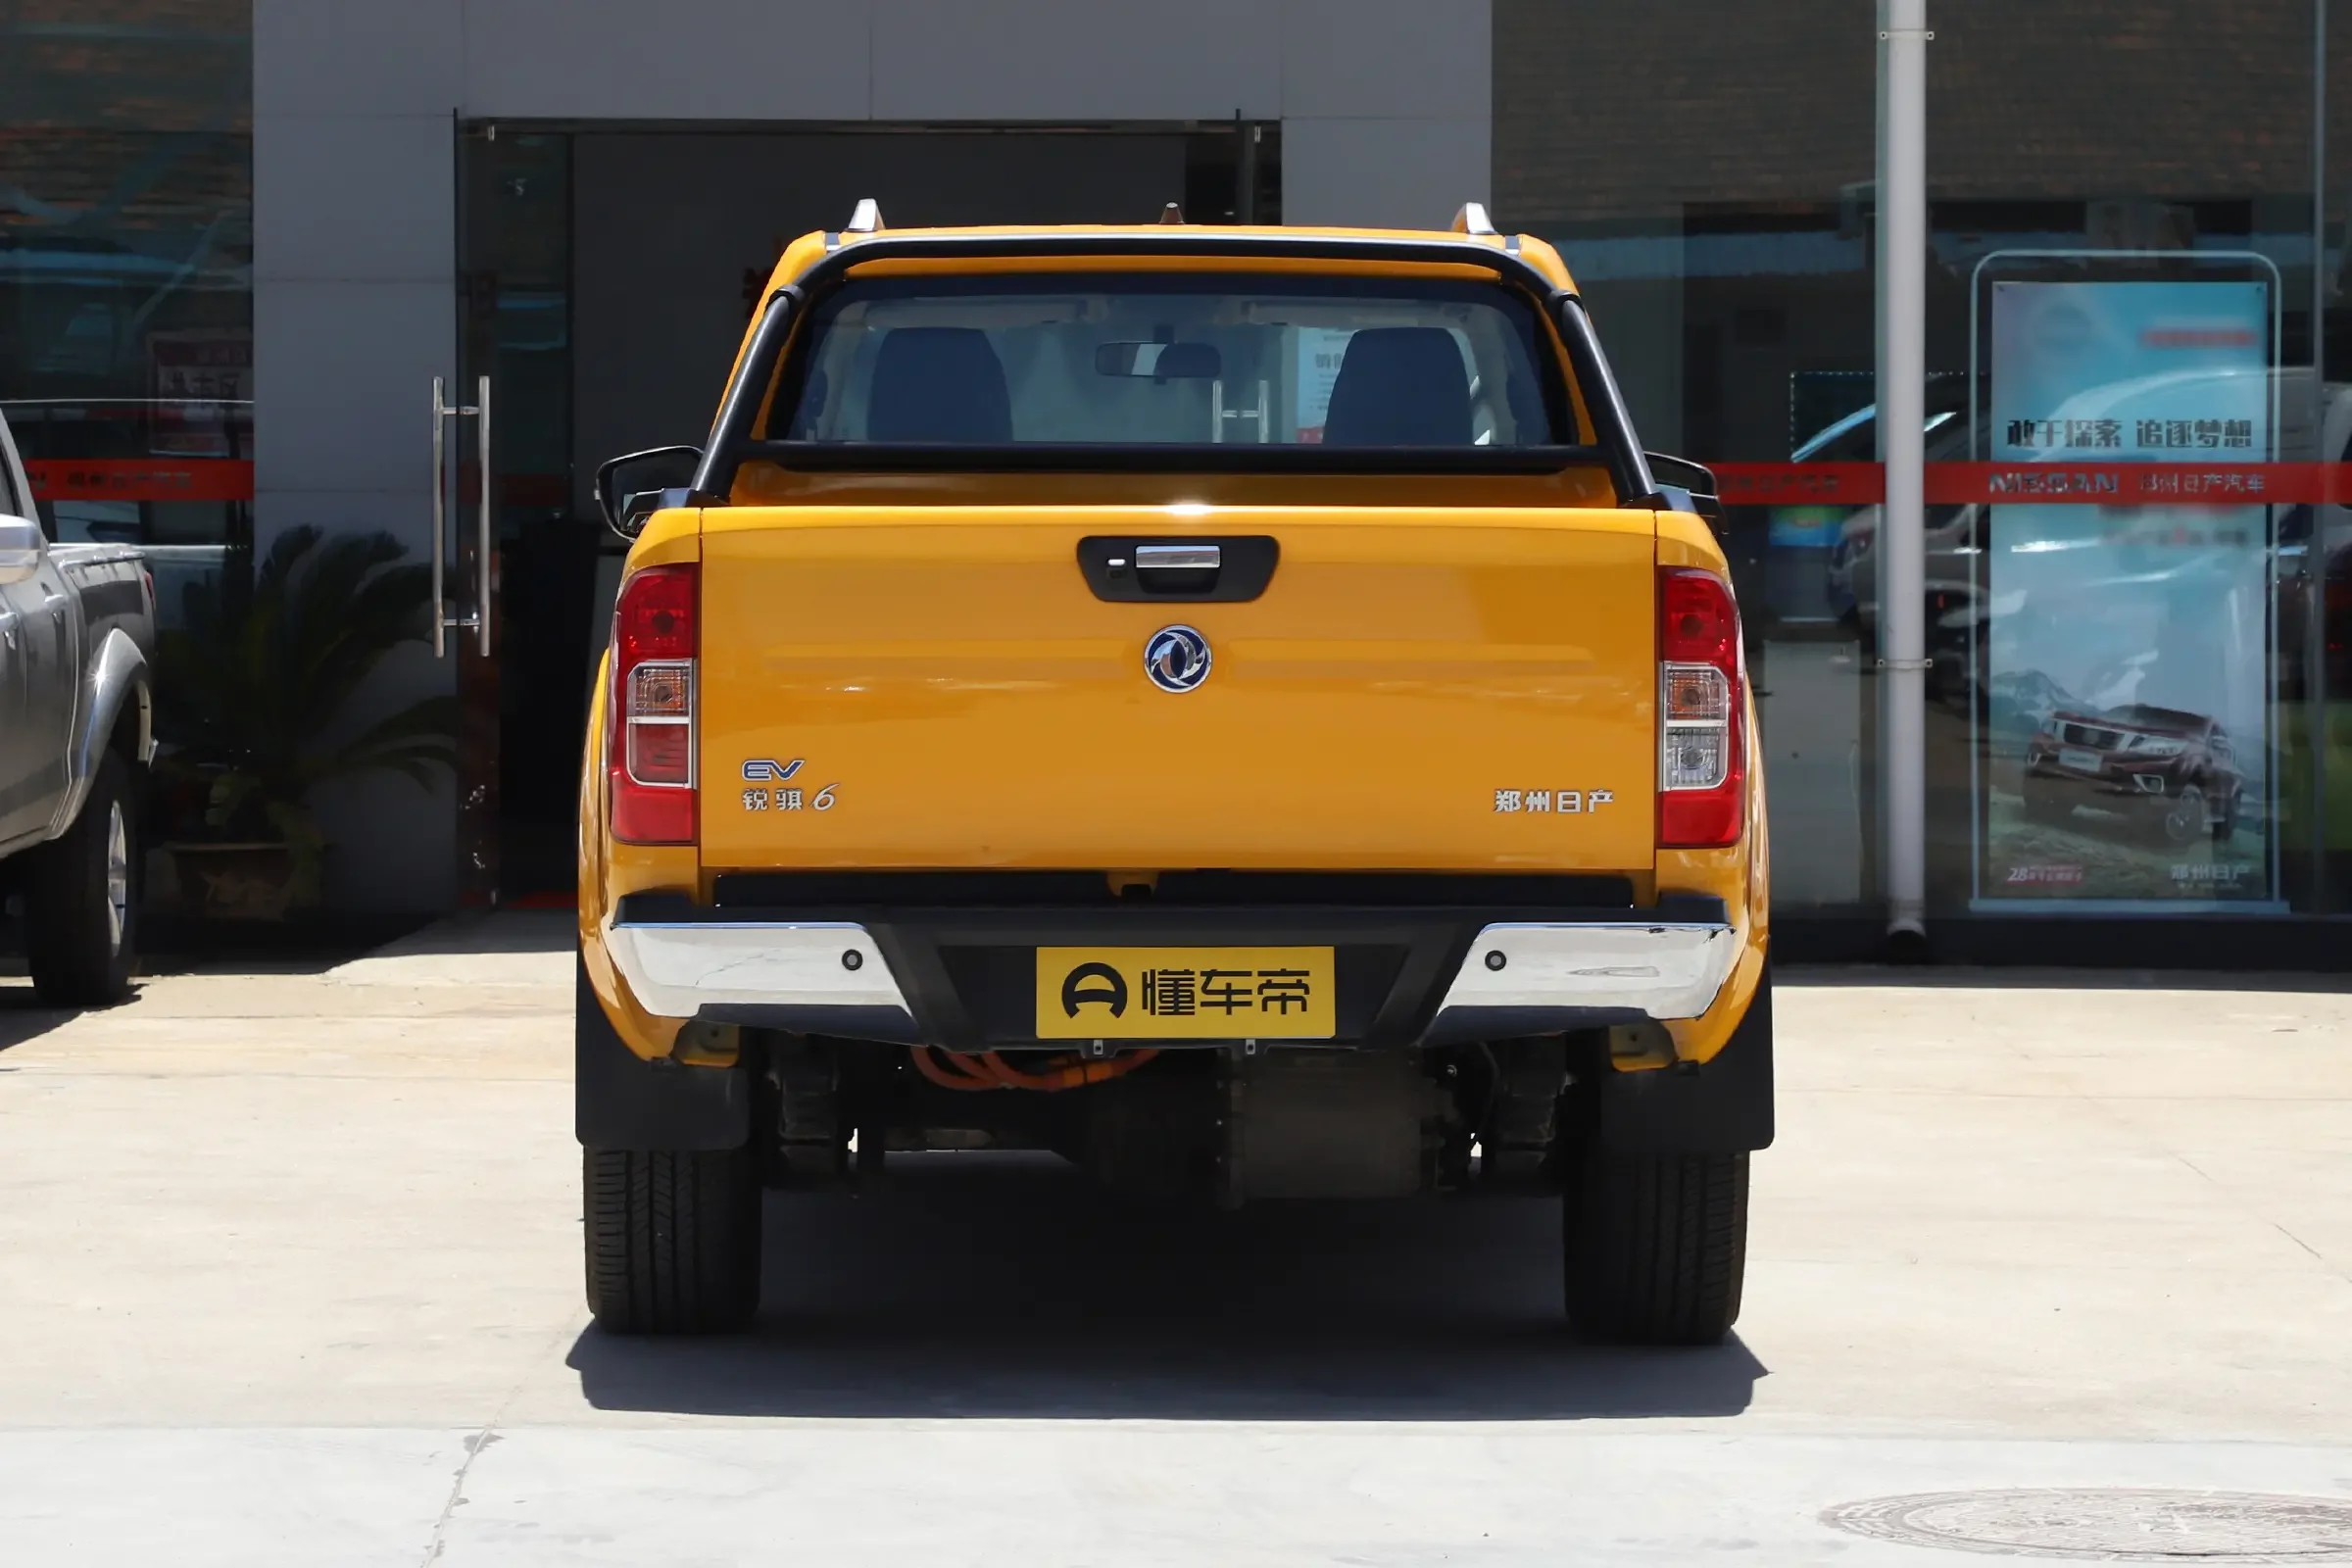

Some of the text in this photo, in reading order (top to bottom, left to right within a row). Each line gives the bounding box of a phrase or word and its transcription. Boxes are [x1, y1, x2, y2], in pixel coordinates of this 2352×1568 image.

[2007, 419, 2252, 448] 敢于探索 追逐梦想
[1988, 472, 2120, 494] NISSAN
[742, 760, 806, 781] EV
[1494, 788, 1614, 813] 郑州日产
[1141, 968, 1310, 1016] 懂车帝
